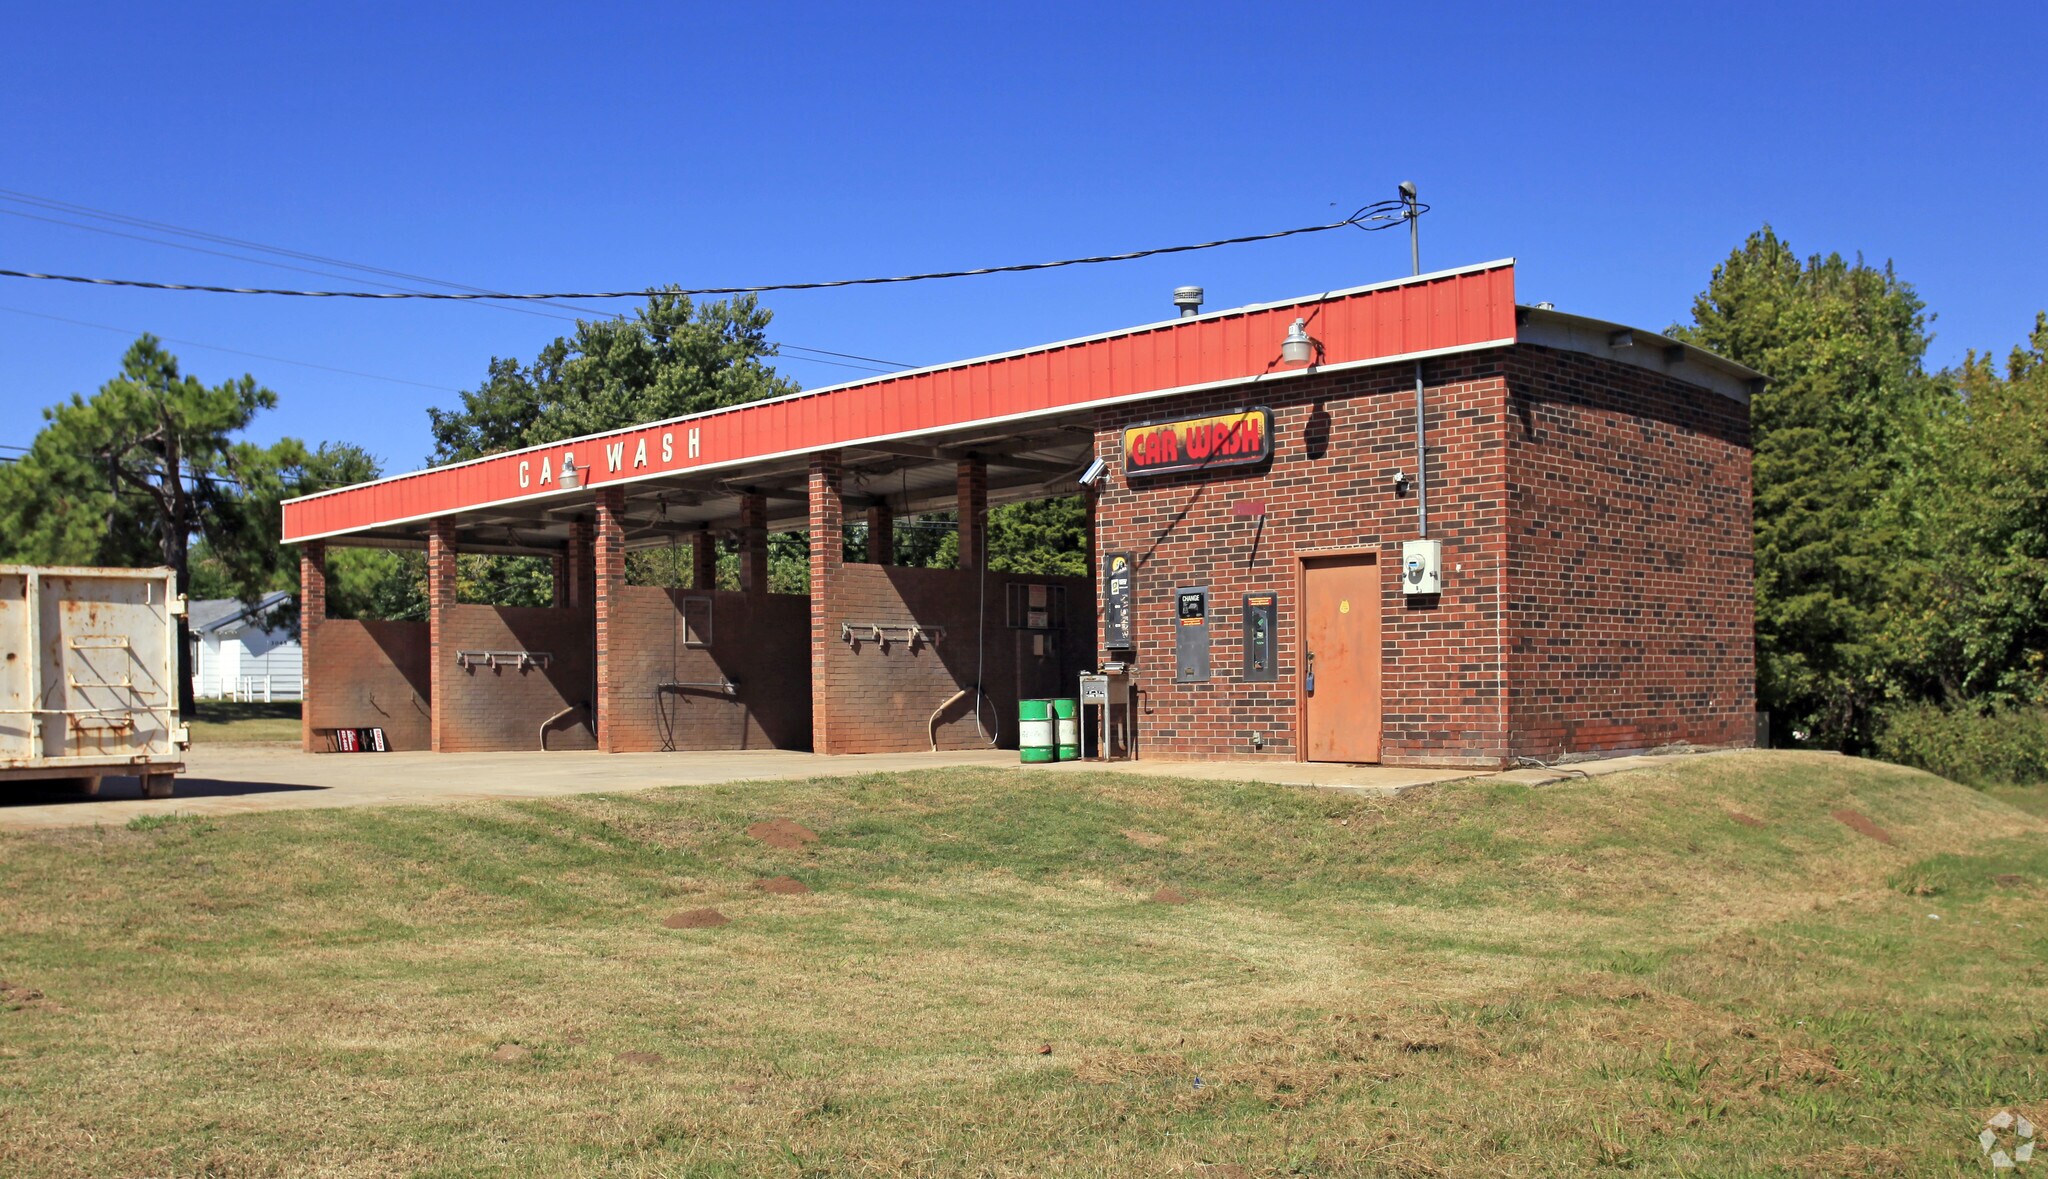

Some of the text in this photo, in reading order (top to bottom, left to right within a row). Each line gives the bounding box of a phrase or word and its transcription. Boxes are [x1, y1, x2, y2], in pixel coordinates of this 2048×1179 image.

[606, 427, 701, 473] WASH
[1132, 418, 1260, 466] CAR WASH
[1182, 594, 1200, 602] CHANGE
